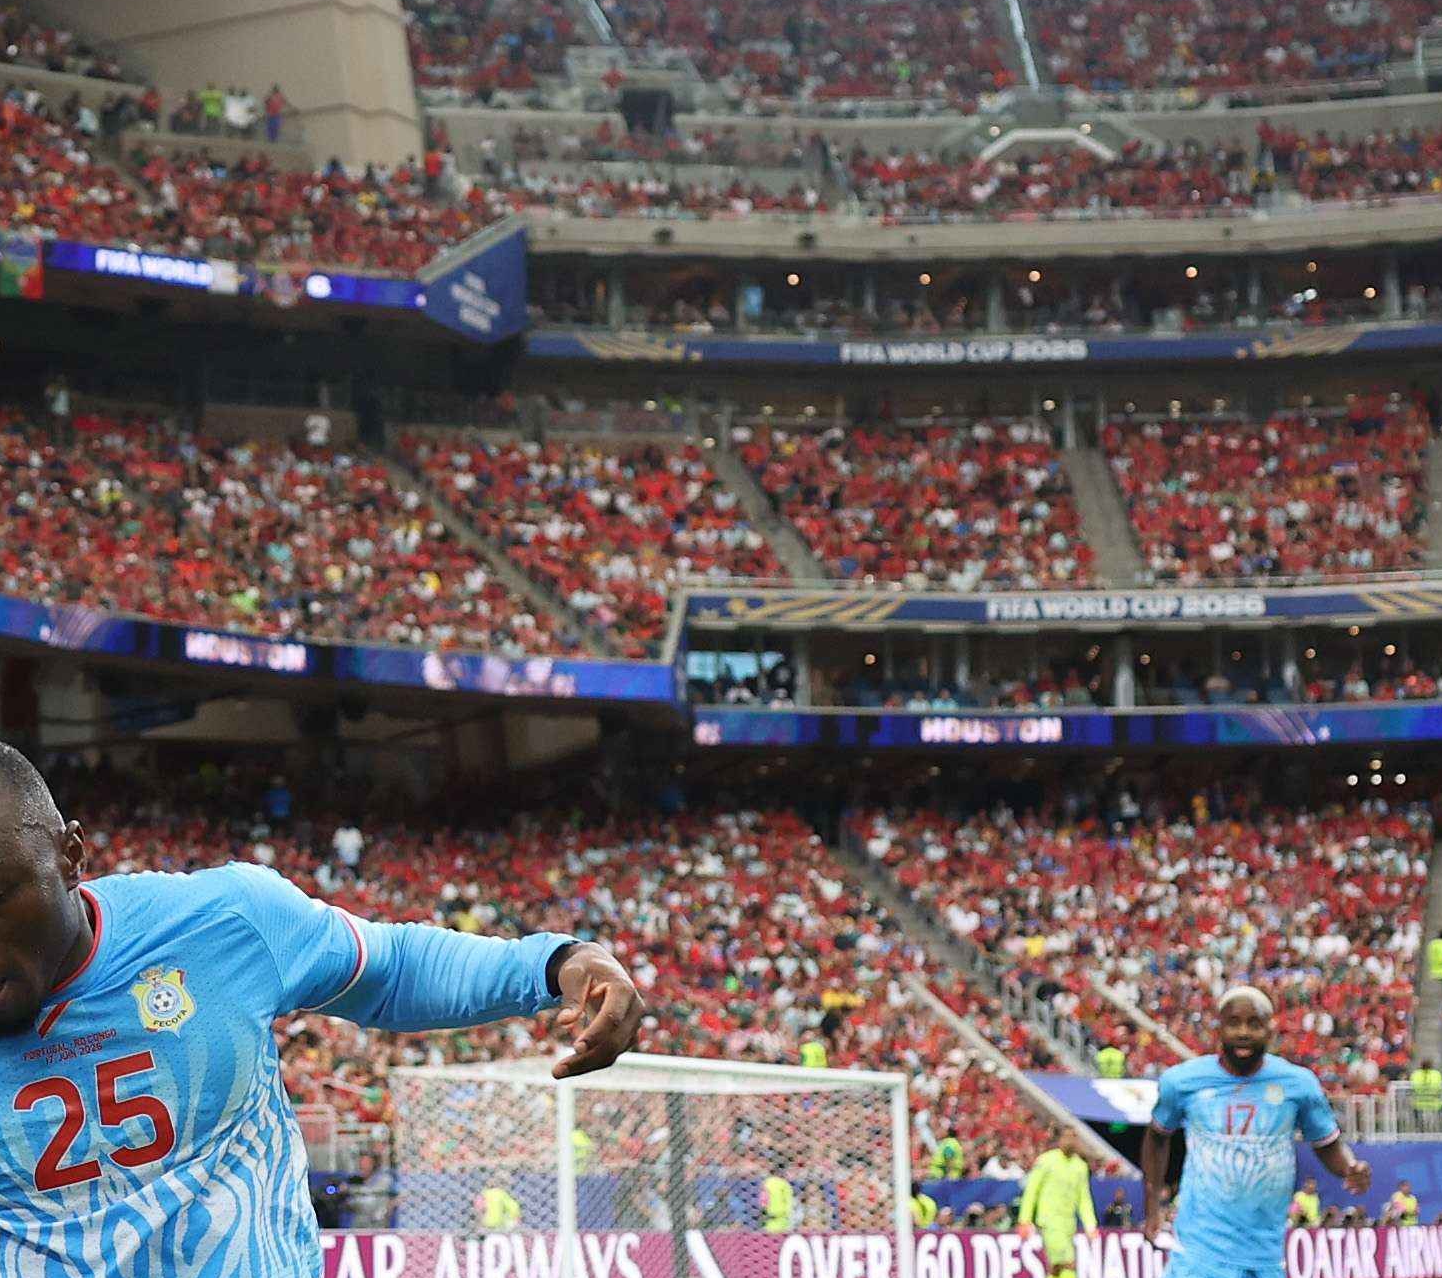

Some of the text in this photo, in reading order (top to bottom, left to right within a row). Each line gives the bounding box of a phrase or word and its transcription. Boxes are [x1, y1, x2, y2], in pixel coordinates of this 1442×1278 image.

[839, 341, 888, 365] FIFA
[888, 341, 966, 364] WORLD
[968, 340, 1013, 363] CUP
[987, 594, 1266, 621] FIFA WORLD CUP 2026
[920, 716, 1063, 743] HOUSTON
[13, 1050, 176, 1193] 25
[1226, 1104, 1258, 1137] 17
